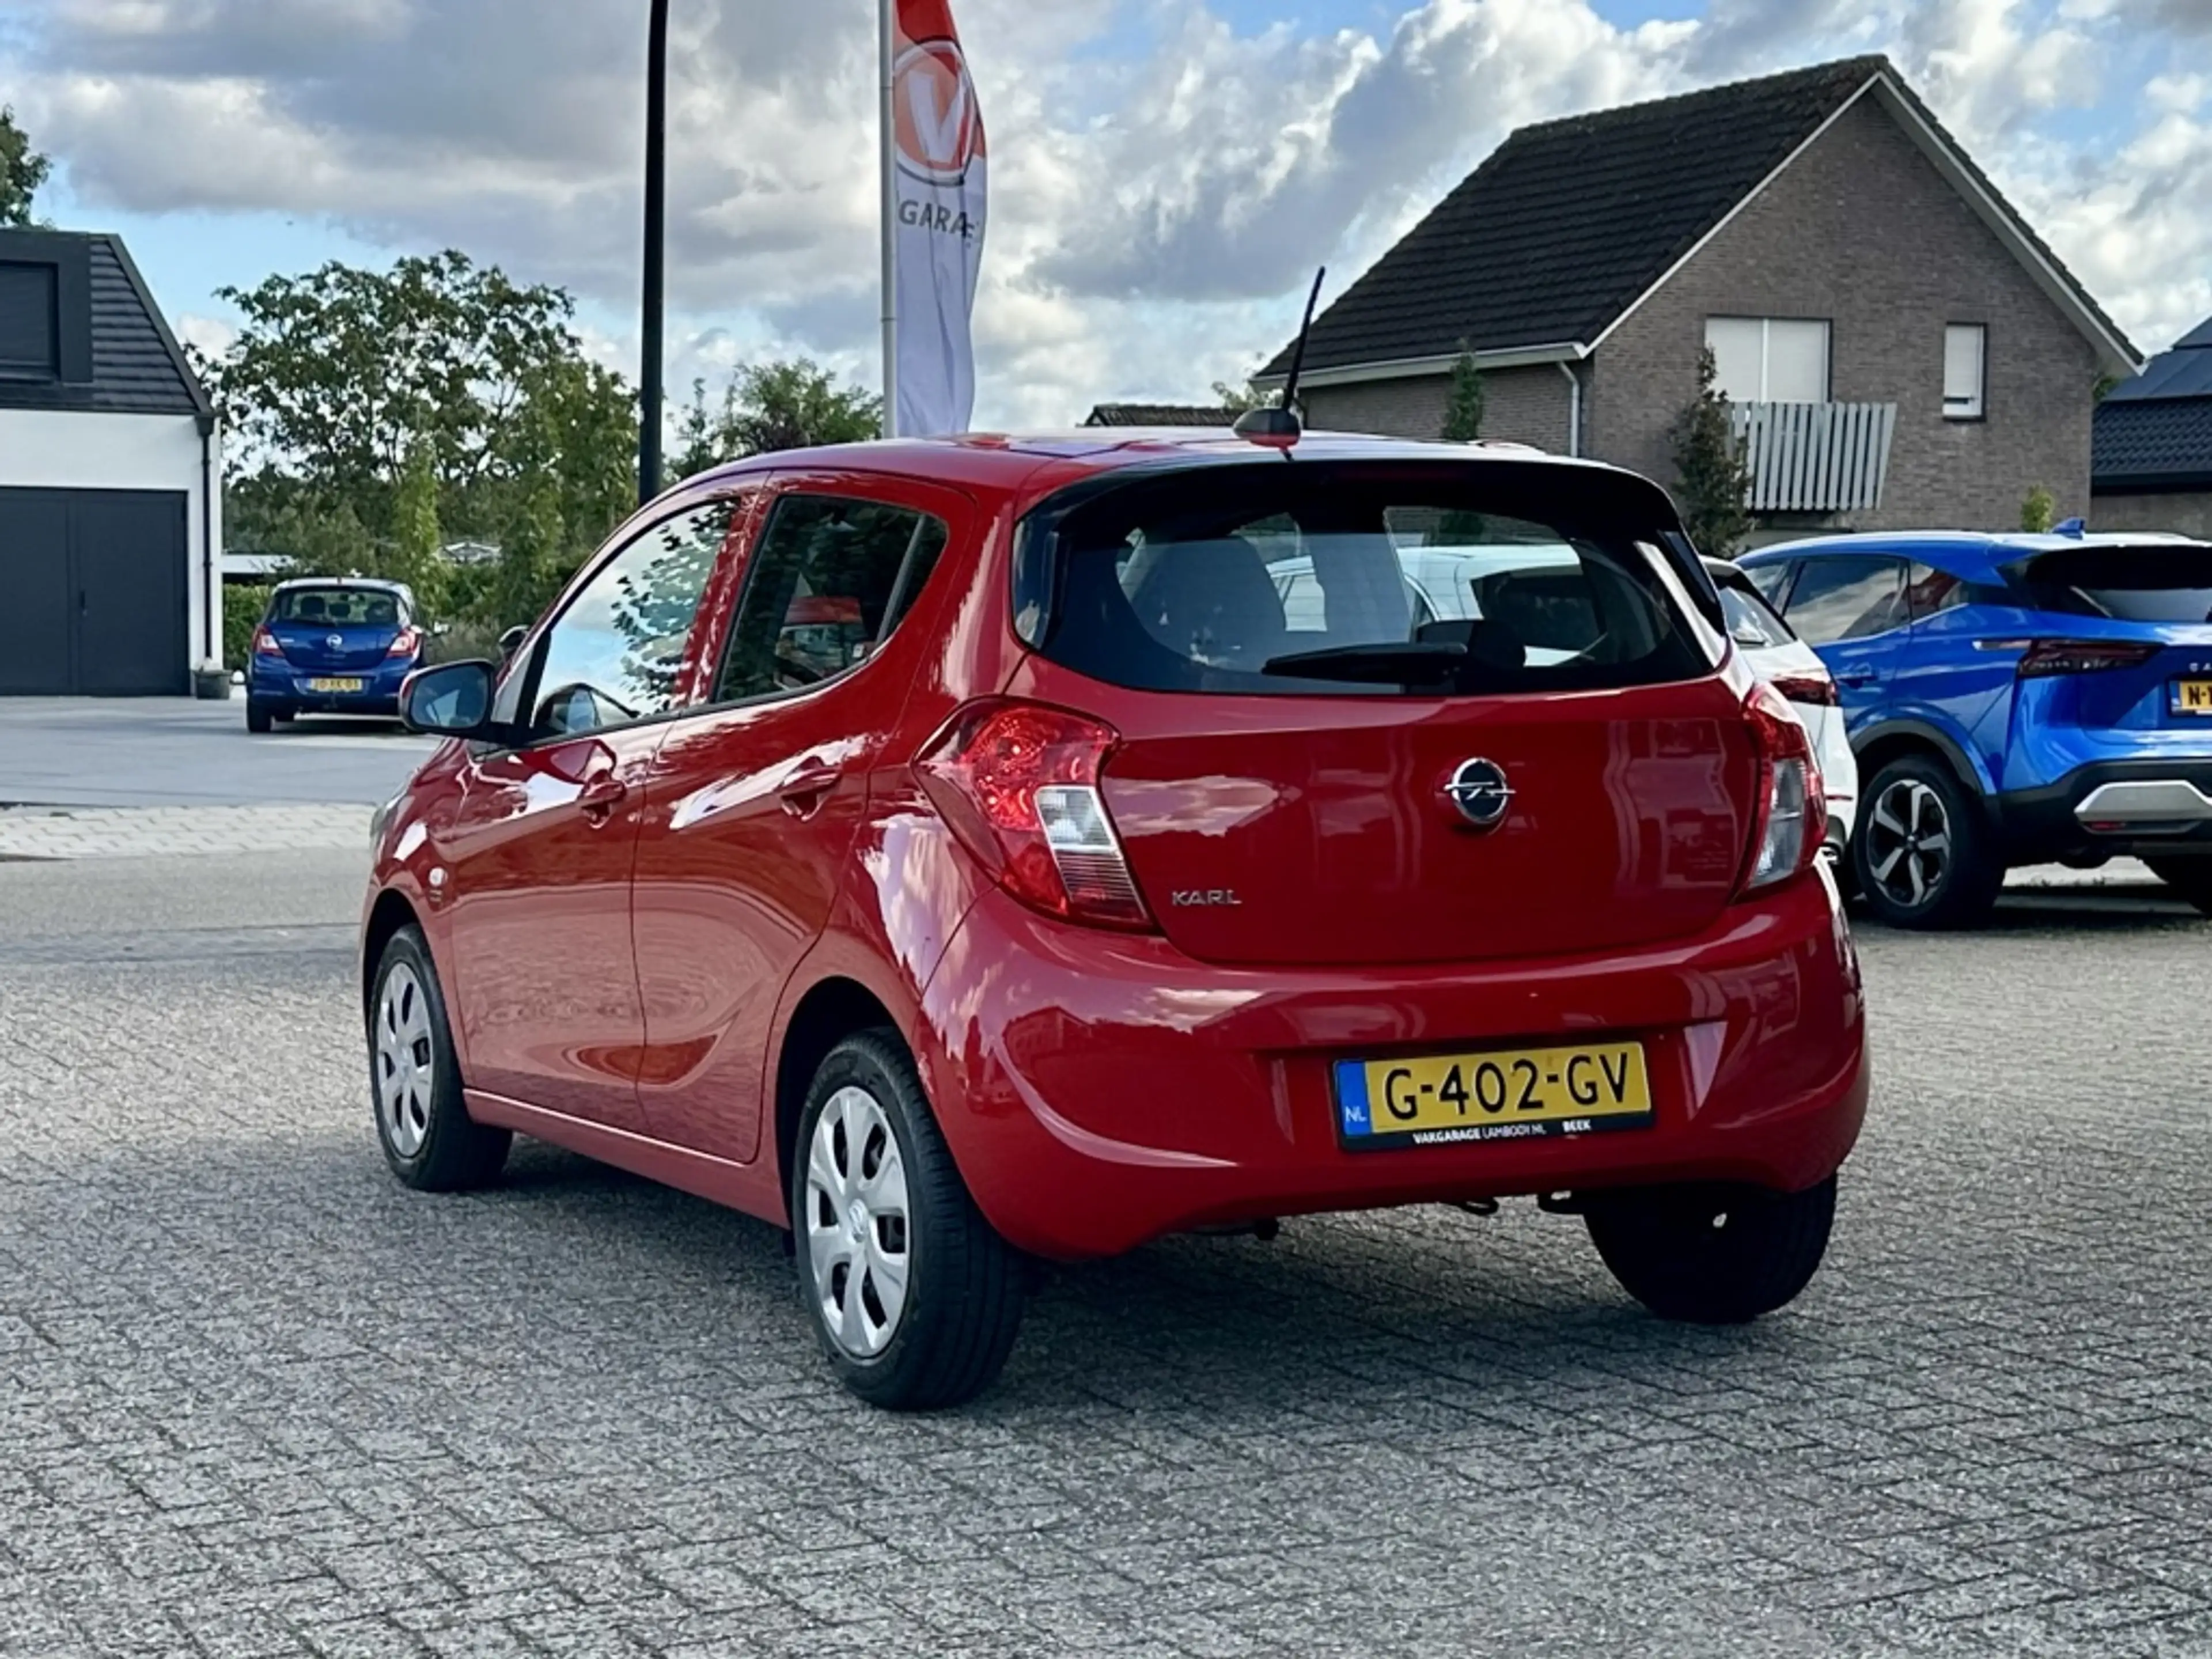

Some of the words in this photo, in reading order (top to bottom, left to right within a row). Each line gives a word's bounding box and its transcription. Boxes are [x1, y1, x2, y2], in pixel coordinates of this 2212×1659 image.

[1172, 889, 1243, 906] KARL
[1385, 1052, 1628, 1120] G-402-GV
[1345, 1105, 1367, 1122] NL
[1562, 1119, 1591, 1132] BEEK
